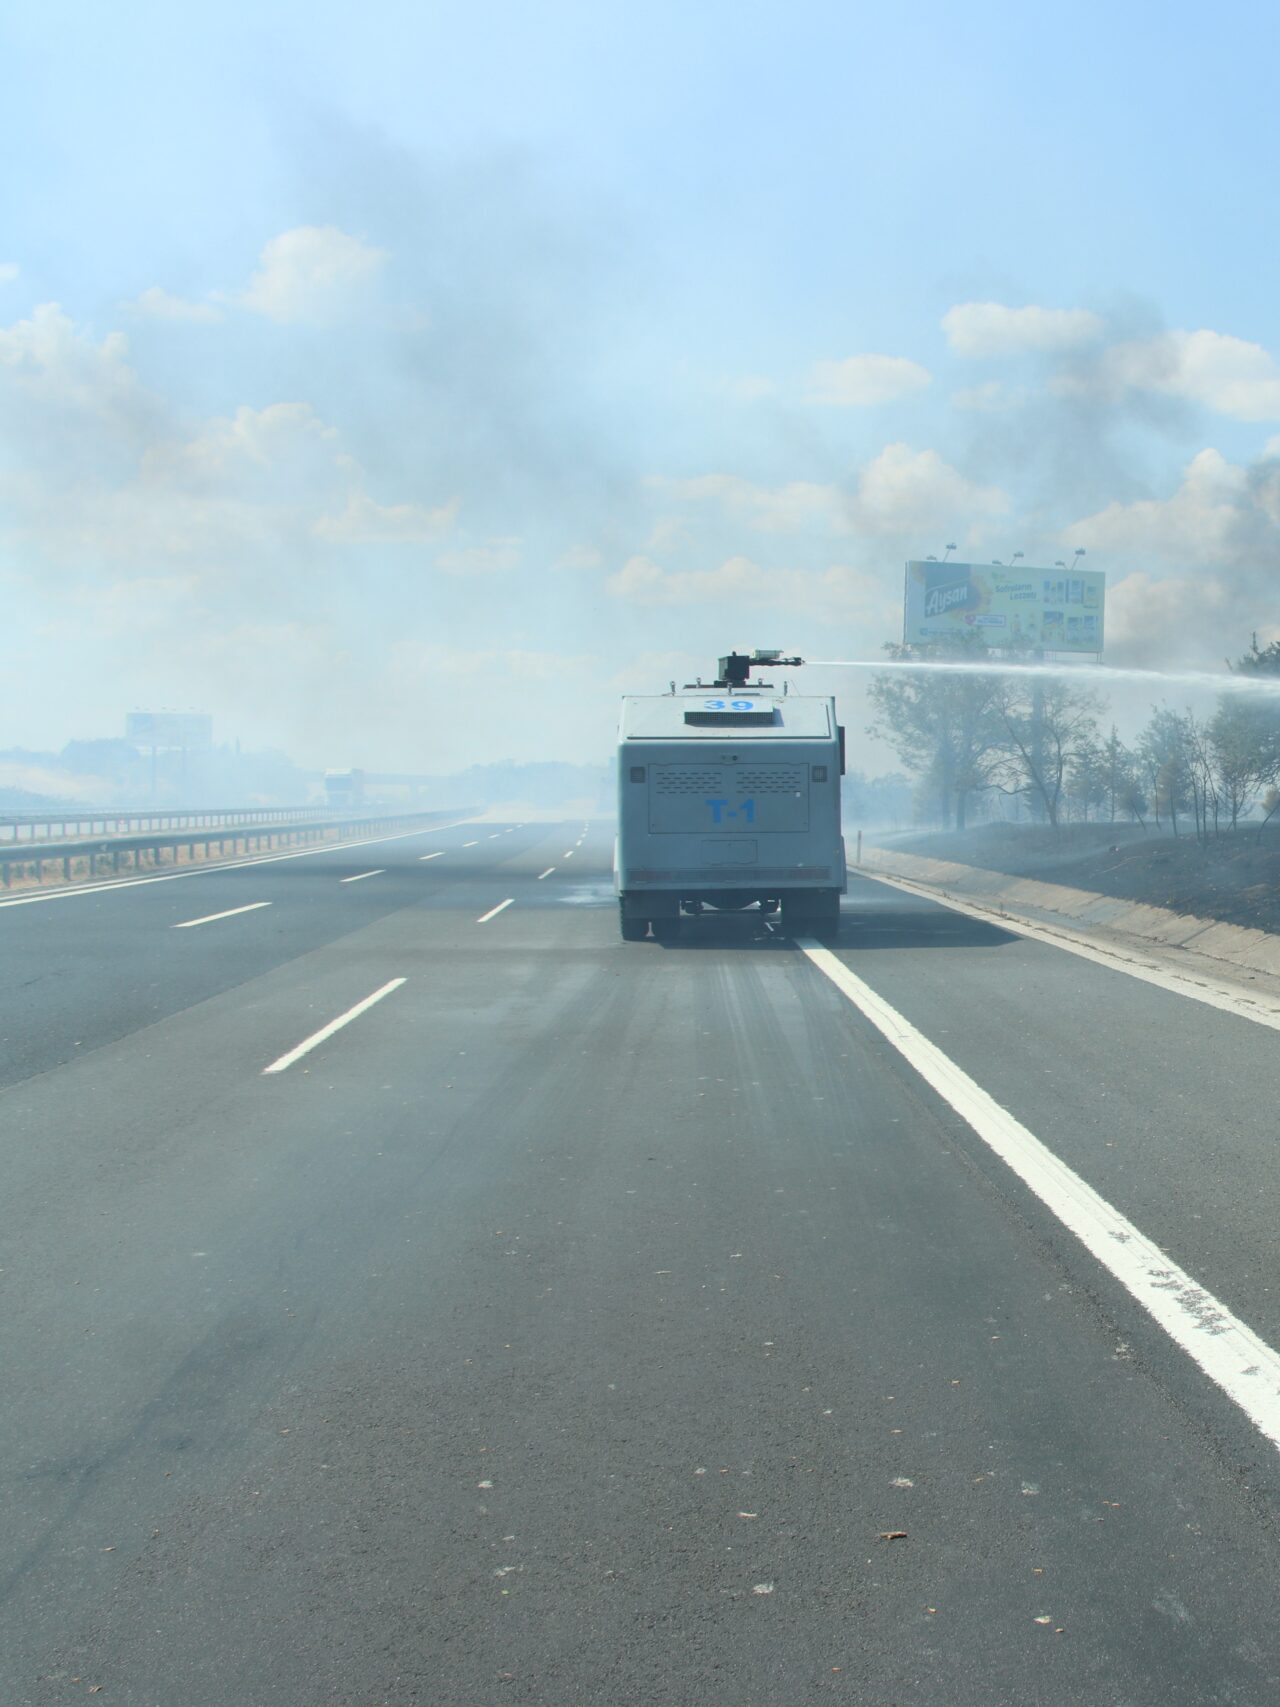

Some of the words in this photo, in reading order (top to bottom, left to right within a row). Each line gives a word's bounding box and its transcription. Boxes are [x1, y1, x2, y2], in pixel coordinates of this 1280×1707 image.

[926, 585, 969, 614] Aysan
[703, 699, 754, 711] 39
[706, 799, 755, 824] T-1
